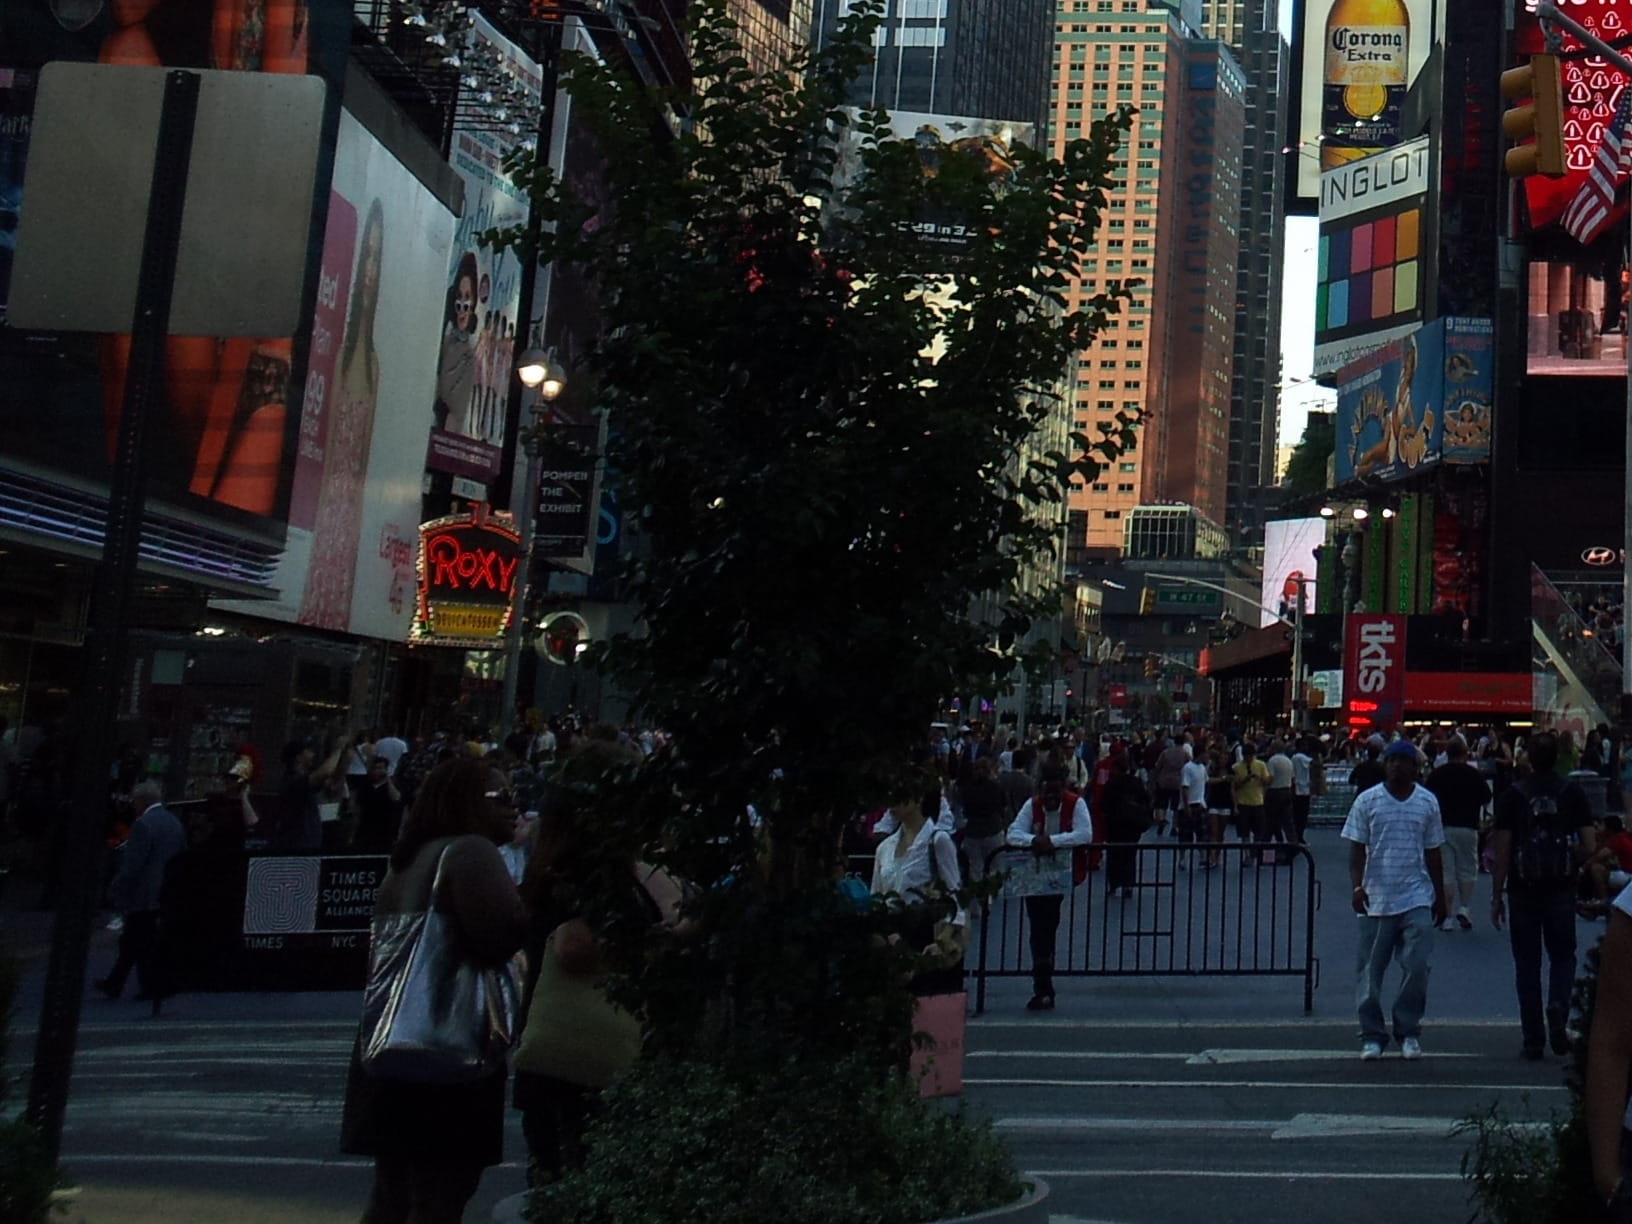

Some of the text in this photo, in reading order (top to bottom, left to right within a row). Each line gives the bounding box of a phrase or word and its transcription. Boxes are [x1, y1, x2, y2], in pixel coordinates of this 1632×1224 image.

[1333, 27, 1402, 51] Corona
[1347, 49, 1392, 62] Extra
[1320, 147, 1428, 208] INGLOT
[541, 487, 564, 496] THE
[540, 503, 583, 513] EXHIBIT
[428, 534, 520, 592] ROXY
[1358, 620, 1397, 694] tkts
[329, 871, 377, 885] TIMES
[321, 888, 379, 903] SQUARE
[325, 906, 376, 917] ALLIANCE
[243, 936, 358, 949] TIMES NYC
